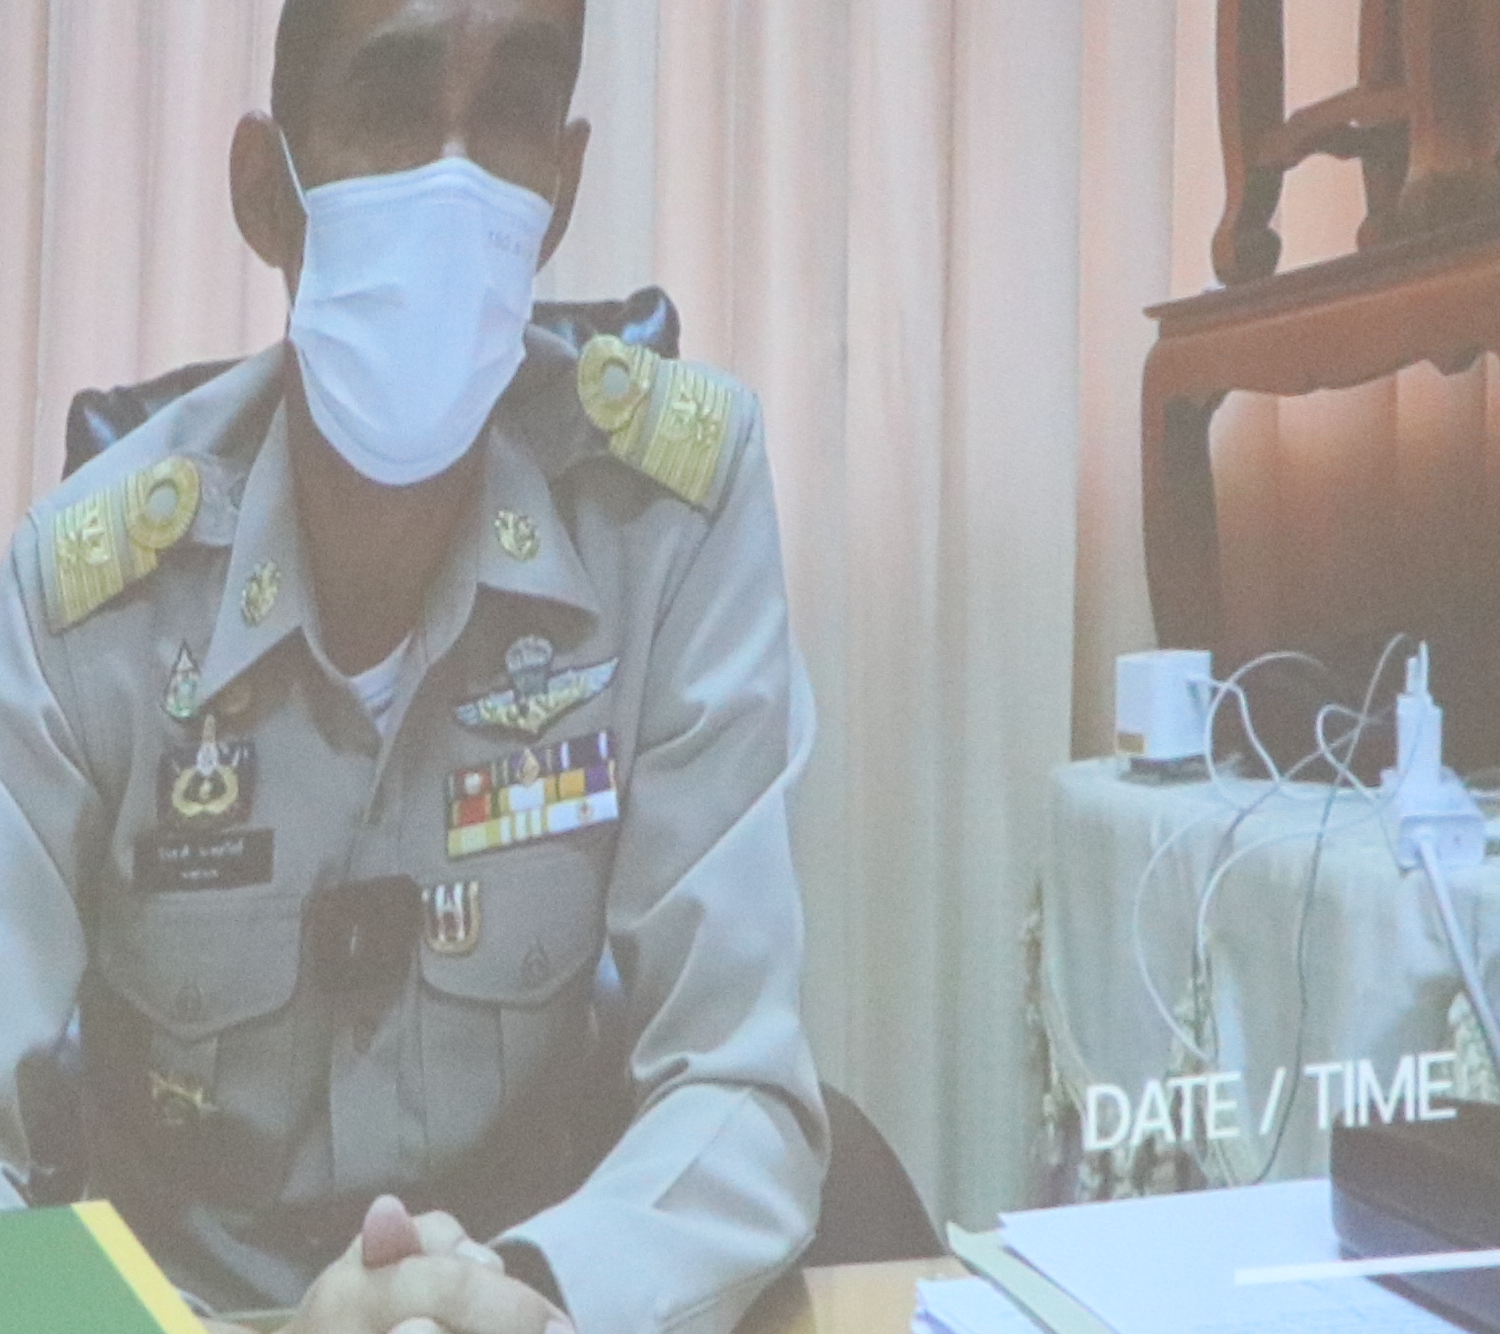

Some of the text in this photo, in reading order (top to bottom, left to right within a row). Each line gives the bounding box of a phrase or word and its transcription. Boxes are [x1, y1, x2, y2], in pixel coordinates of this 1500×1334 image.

[1081, 1050, 1458, 1152] DATE / TIME
